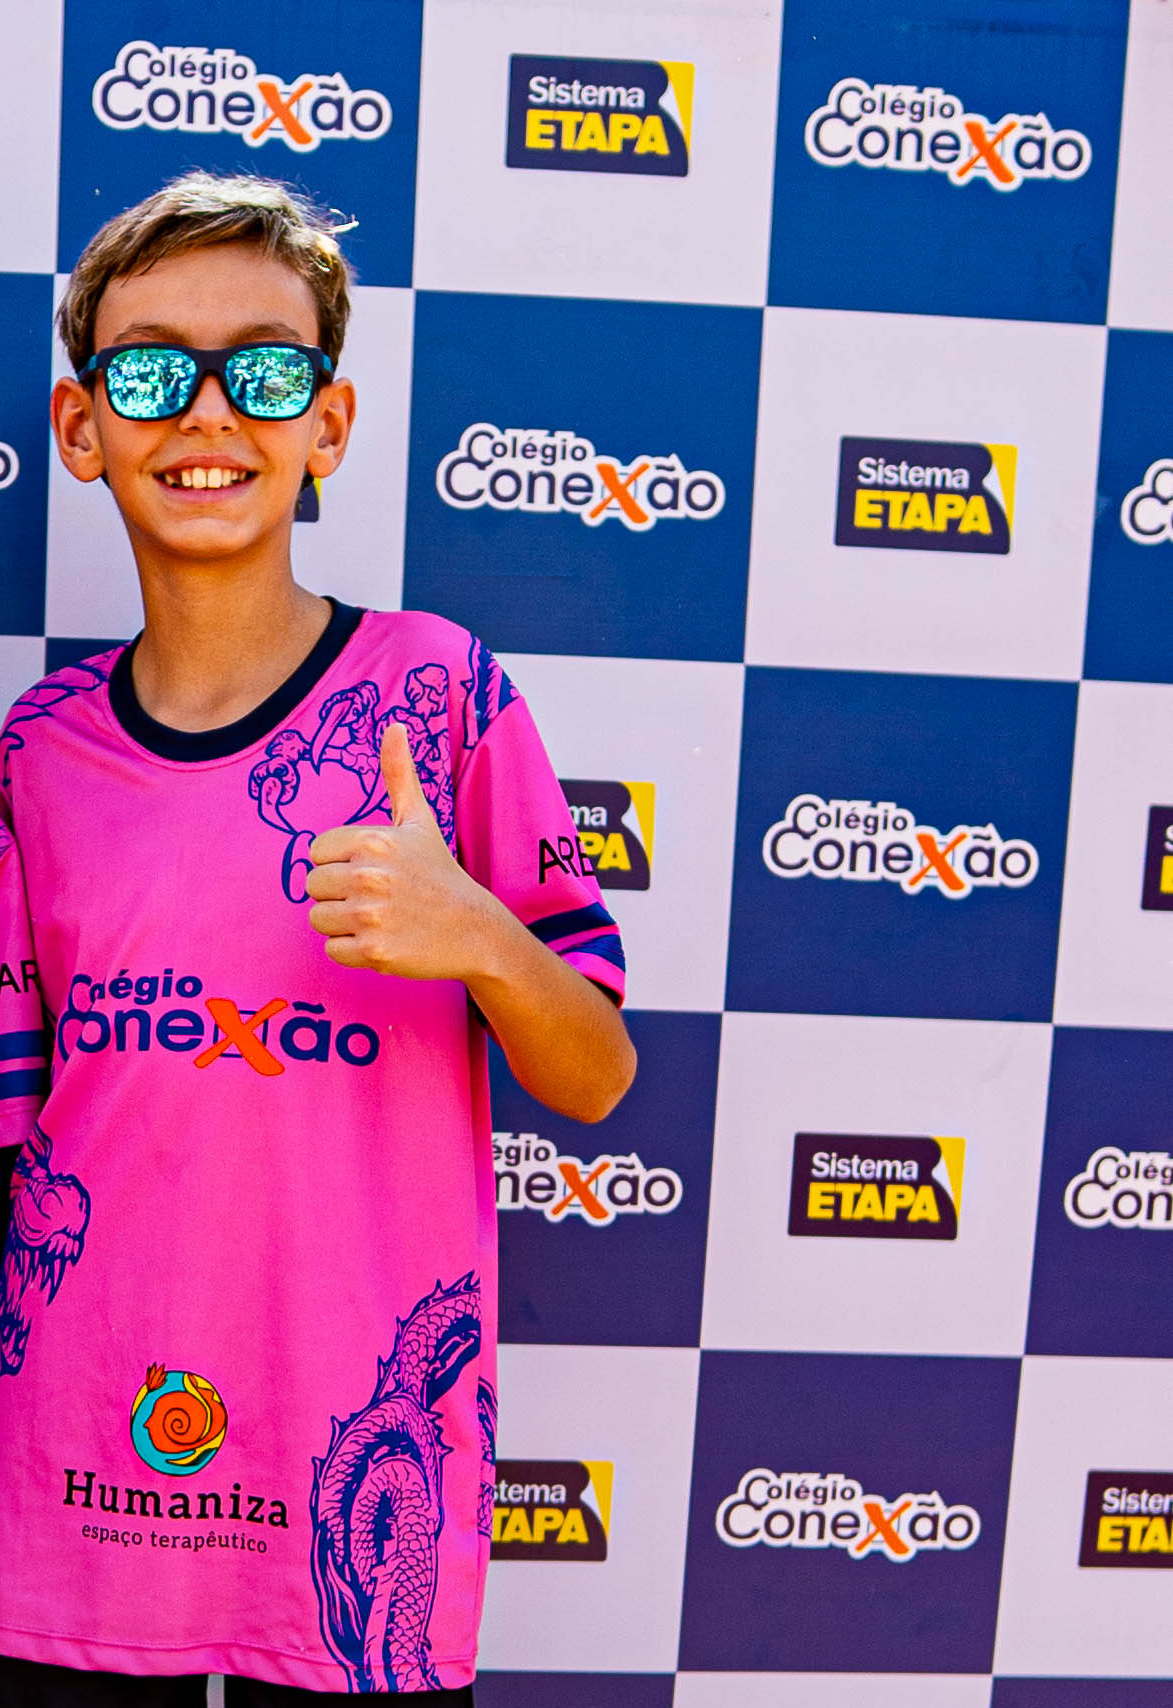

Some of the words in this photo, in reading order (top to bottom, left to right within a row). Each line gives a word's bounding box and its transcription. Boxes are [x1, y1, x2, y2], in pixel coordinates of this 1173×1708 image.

[126, 49, 248, 85] Colégio
[528, 75, 644, 108] Sistema
[836, 85, 956, 122] Colégio
[525, 110, 669, 156] ETAPA
[467, 430, 587, 464] Colégio
[858, 457, 969, 489] Sistema
[853, 490, 993, 535] ETAPA
[793, 802, 907, 834] Colégio
[538, 835, 594, 884] ARE
[812, 1152, 919, 1180] Sistema
[1095, 1155, 1173, 1185] Colég
[495, 1162, 675, 1219] neXão
[807, 1182, 941, 1223] ETAPA
[62, 1470, 290, 1528] Humaniza
[494, 1480, 567, 1503] tema
[744, 1475, 856, 1505] Colégio
[1103, 1489, 1173, 1514] Siste
[82, 1524, 143, 1547] espaço
[150, 1528, 268, 1554] terapêutico
[492, 1507, 589, 1543] TAPA
[1098, 1517, 1173, 1553] ETA
